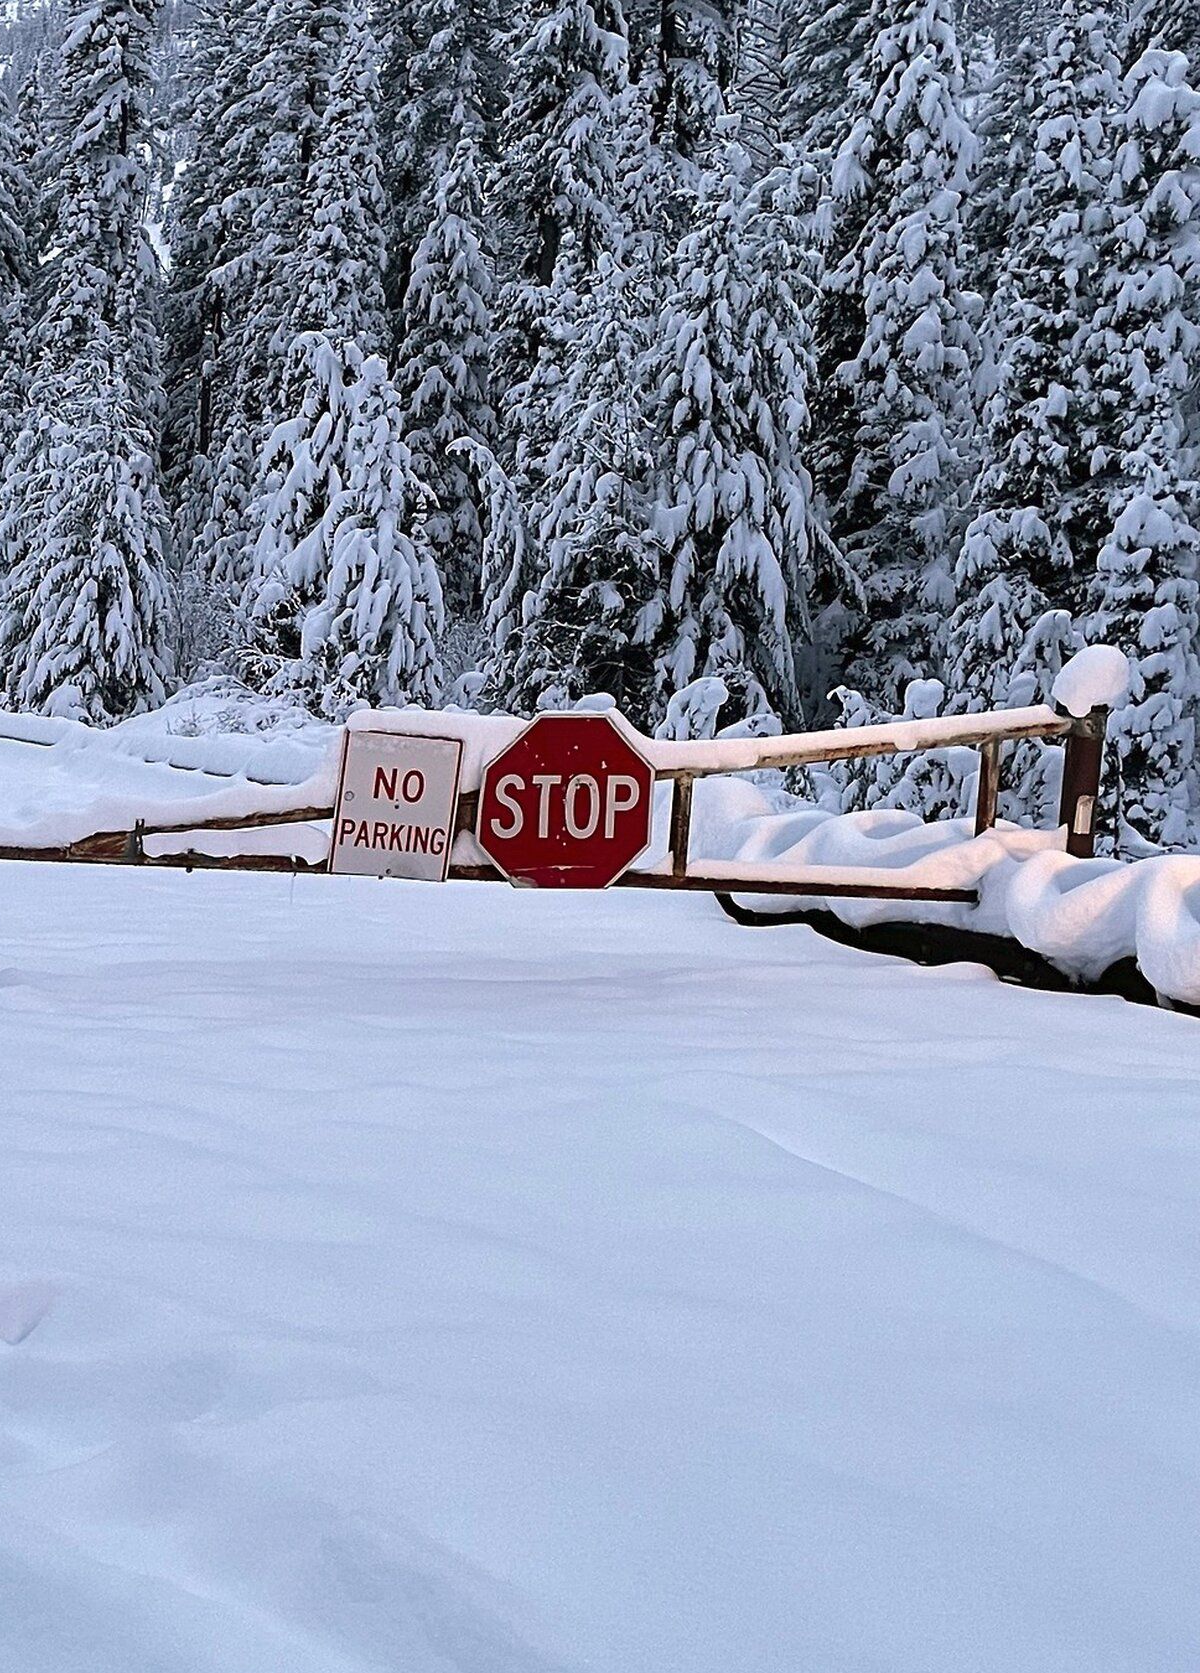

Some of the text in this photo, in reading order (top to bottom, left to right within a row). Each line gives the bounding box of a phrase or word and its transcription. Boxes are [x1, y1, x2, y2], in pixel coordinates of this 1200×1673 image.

[373, 767, 425, 803] NO
[490, 774, 640, 839] STOP
[339, 818, 446, 856] PARKING
